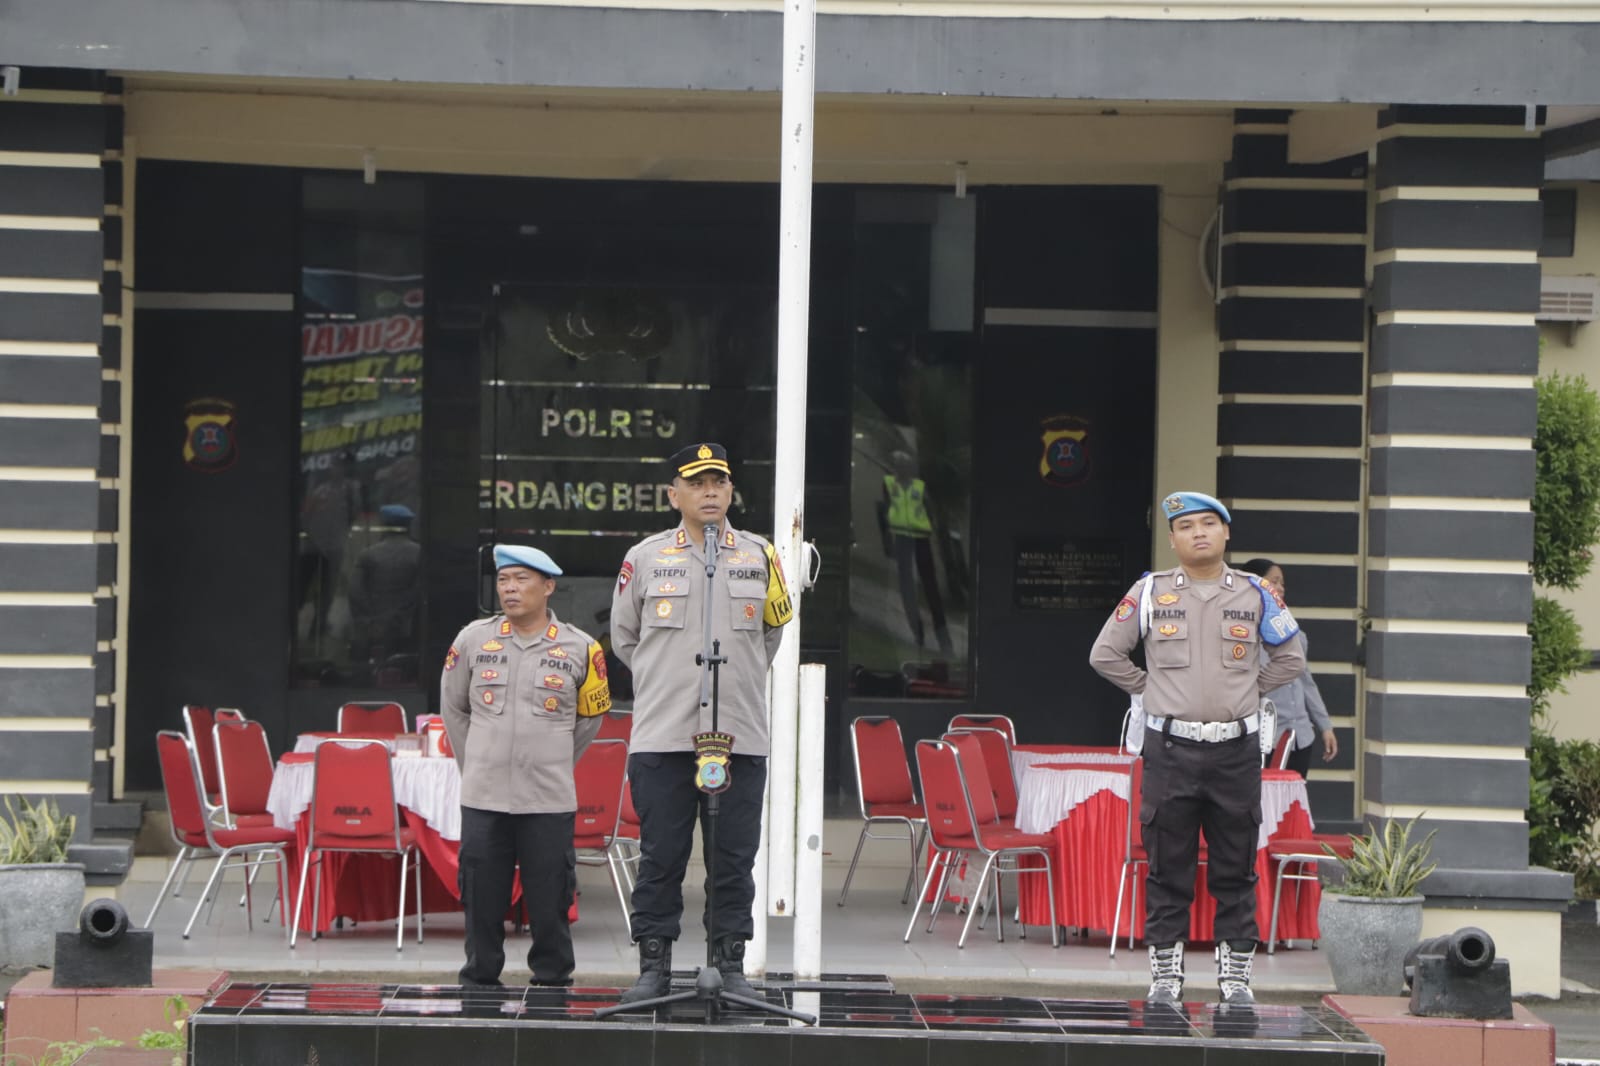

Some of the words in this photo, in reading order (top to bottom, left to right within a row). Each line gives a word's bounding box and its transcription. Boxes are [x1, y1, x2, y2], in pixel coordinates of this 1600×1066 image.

[653, 568, 686, 578] SITEPU
[729, 569, 761, 579] POLRI
[1223, 609, 1255, 621] POLRI
[475, 654, 499, 664] FRIDO
[540, 658, 573, 673] POLRI
